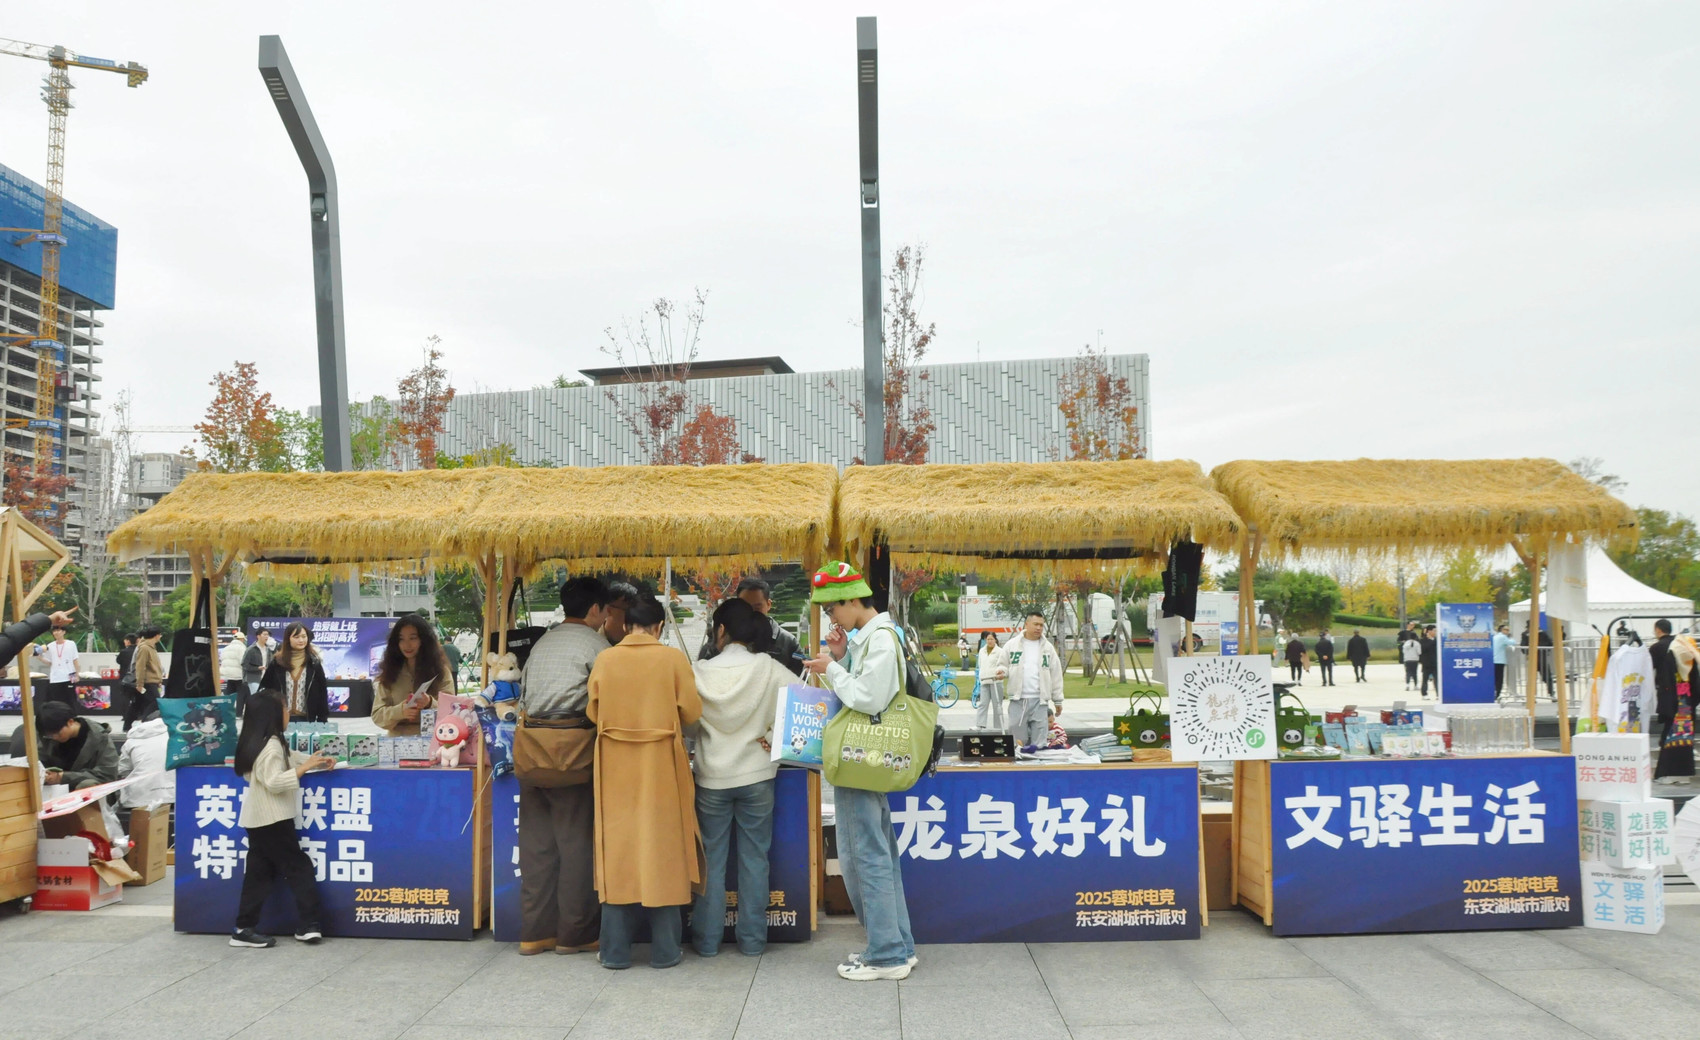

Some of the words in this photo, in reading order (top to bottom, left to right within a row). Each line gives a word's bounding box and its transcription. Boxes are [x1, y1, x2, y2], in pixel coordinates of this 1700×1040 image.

[1453, 658, 1483, 669] 卫生间
[793, 701, 815, 715] THE
[846, 723, 911, 739] INVICTUS
[1578, 754, 1606, 762] DONG
[1607, 754, 1620, 762] AN
[1578, 765, 1638, 784] 东安湖
[195, 784, 373, 832] 英联盟
[1284, 780, 1547, 850] 文驿生活
[890, 793, 1167, 861] 龙泉好礼
[1627, 810, 1669, 831] 龙泉
[1628, 836, 1671, 859] 好礼
[1463, 875, 1559, 895] 2025蓉城电竞
[1593, 879, 1646, 902] 文驿
[355, 887, 450, 906] 2025蓉城电竞
[1075, 888, 1176, 907] 2025蓉城电竞
[1464, 895, 1571, 915] 东安湖城市派对
[355, 906, 461, 926] 东安湖城市派对
[1075, 908, 1187, 928] 东安湖城市派对
[1593, 901, 1646, 926] 生活
